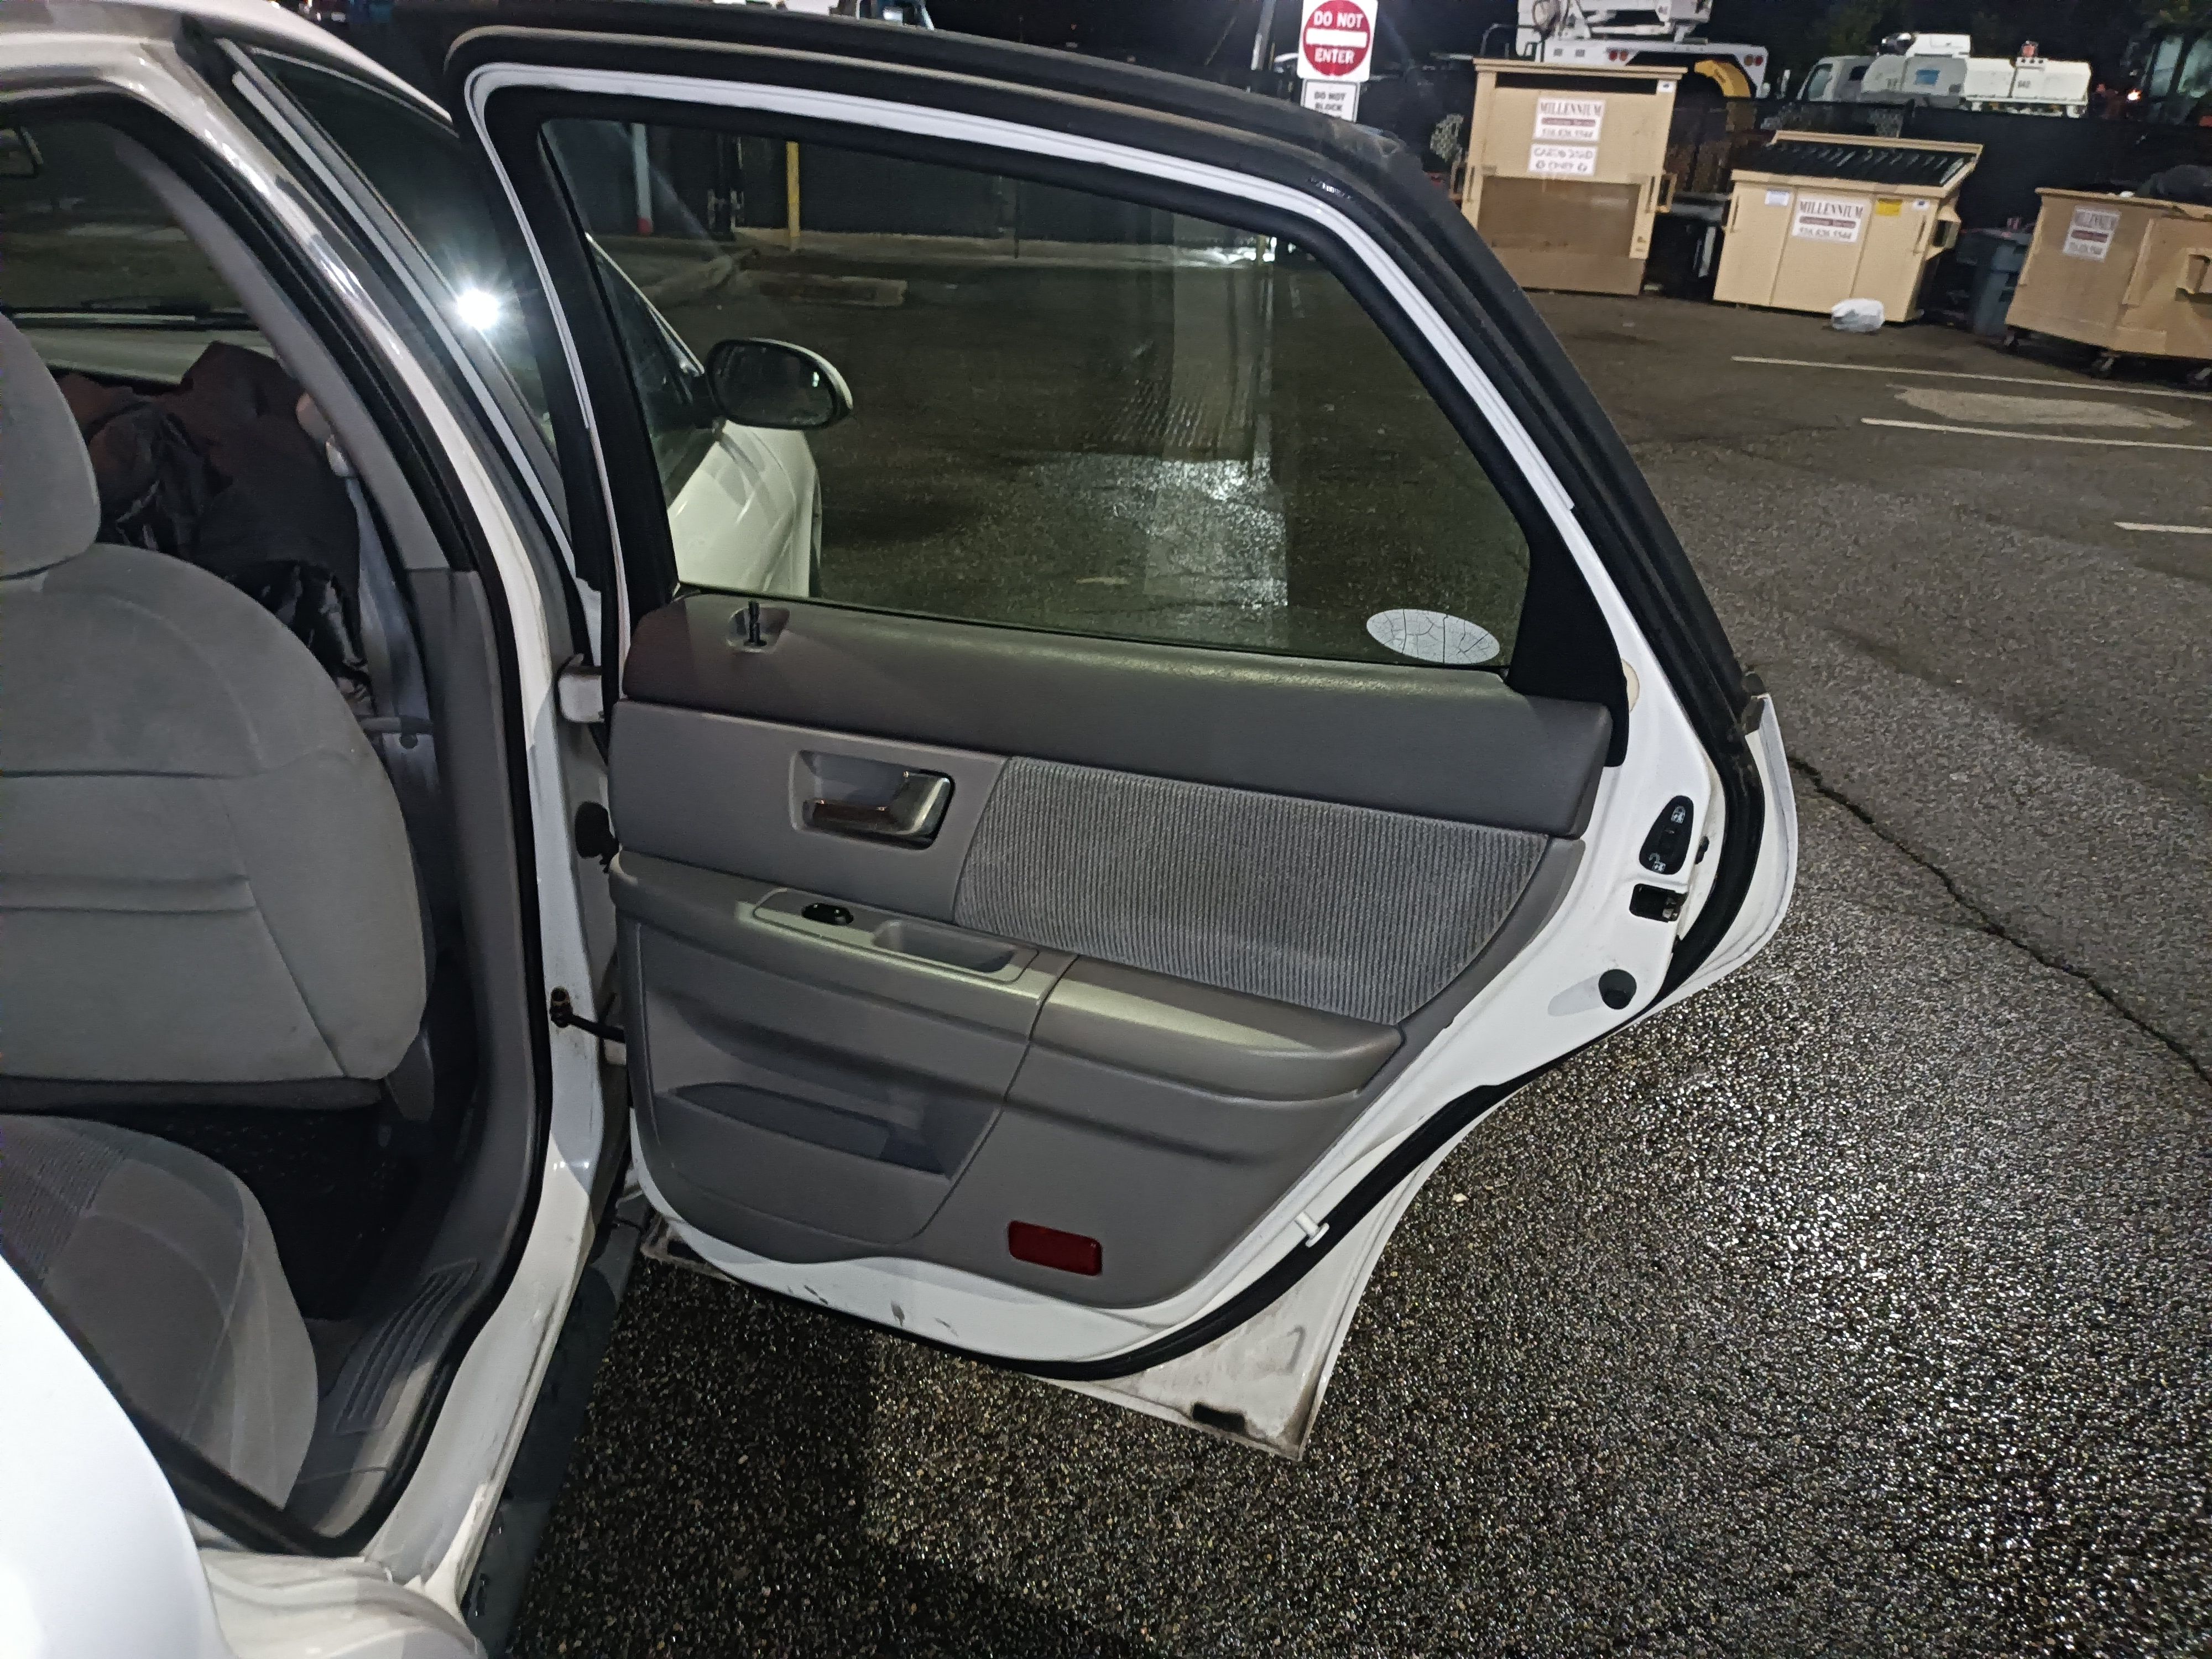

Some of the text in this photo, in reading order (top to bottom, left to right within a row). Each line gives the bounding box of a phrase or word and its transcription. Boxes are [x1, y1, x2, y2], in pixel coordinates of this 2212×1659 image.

[1313, 11, 1363, 28] DO NOT
[1314, 47, 1354, 64] ENTER
[1540, 102, 1602, 117] MILLENNIUM
[1799, 201, 1864, 219] MILLENNIUM
